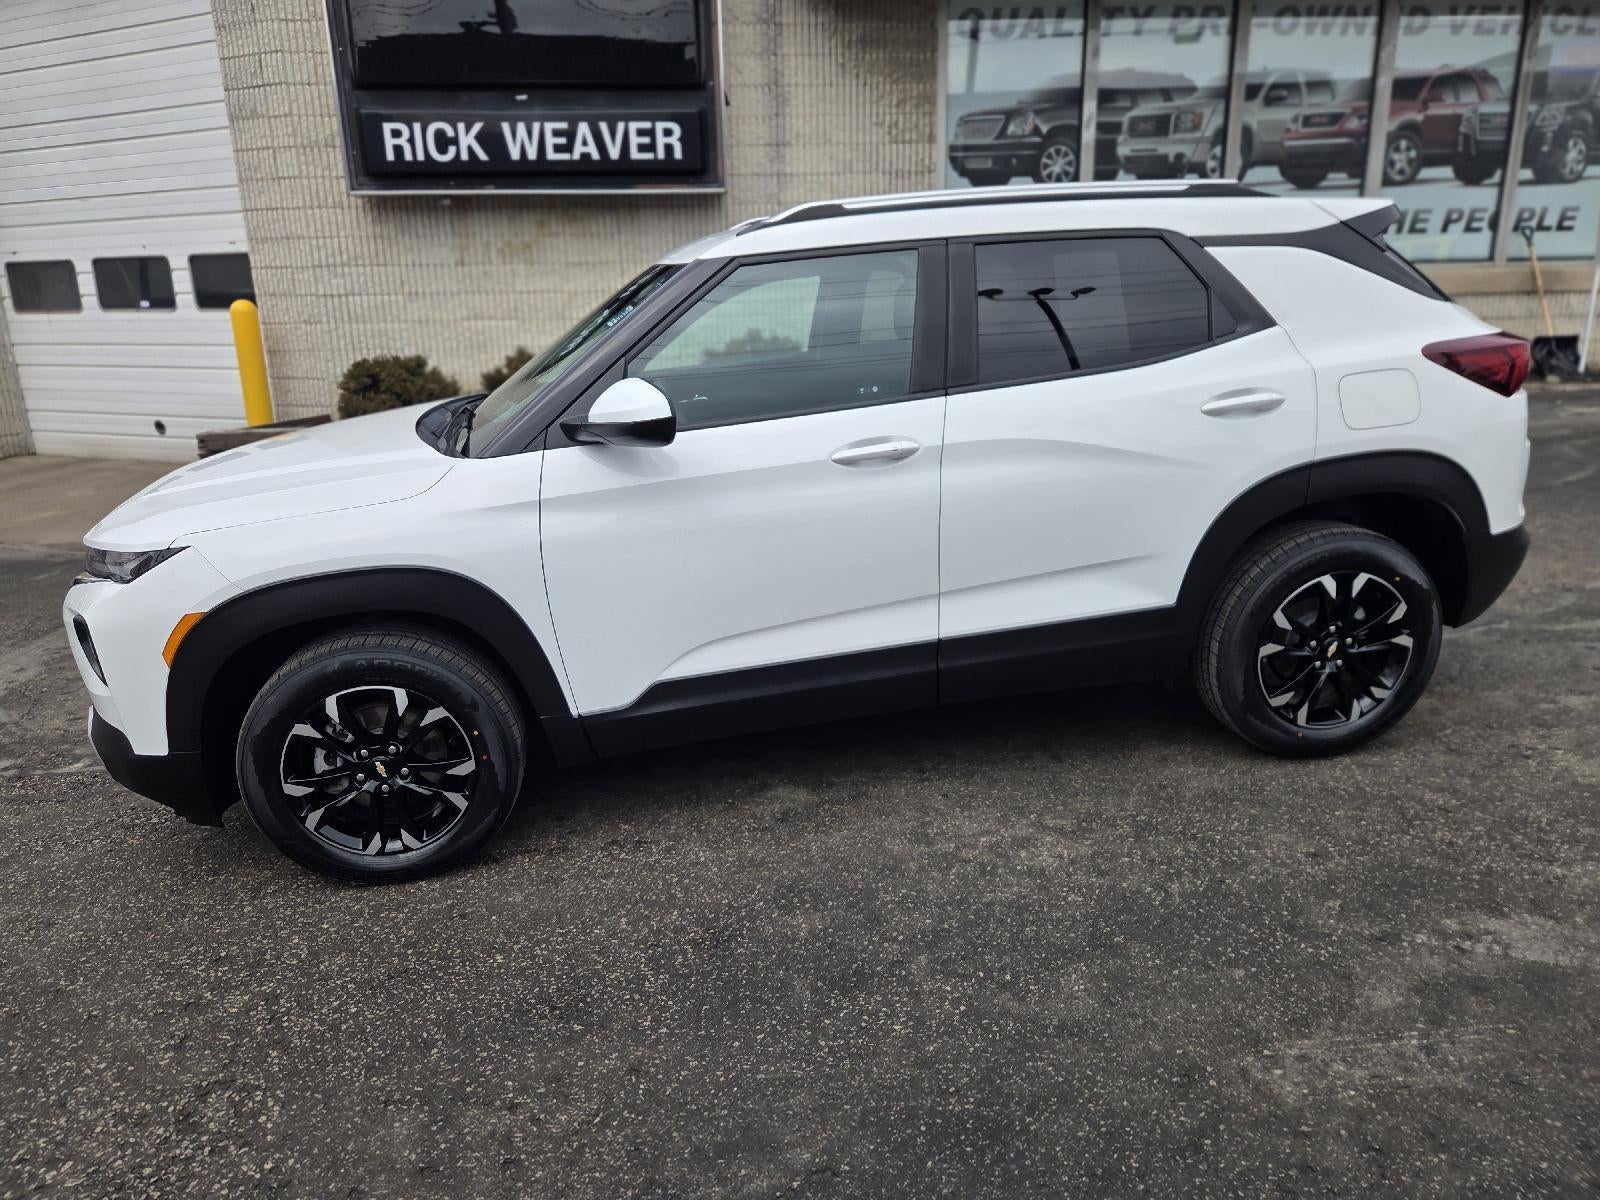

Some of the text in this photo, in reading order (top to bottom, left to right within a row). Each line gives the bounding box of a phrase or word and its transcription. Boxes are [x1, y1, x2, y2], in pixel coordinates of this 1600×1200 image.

[956, 6, 1157, 39] QUALTY
[1167, 5, 1431, 38] PR-OWND
[381, 121, 684, 162] RICK WEAVER
